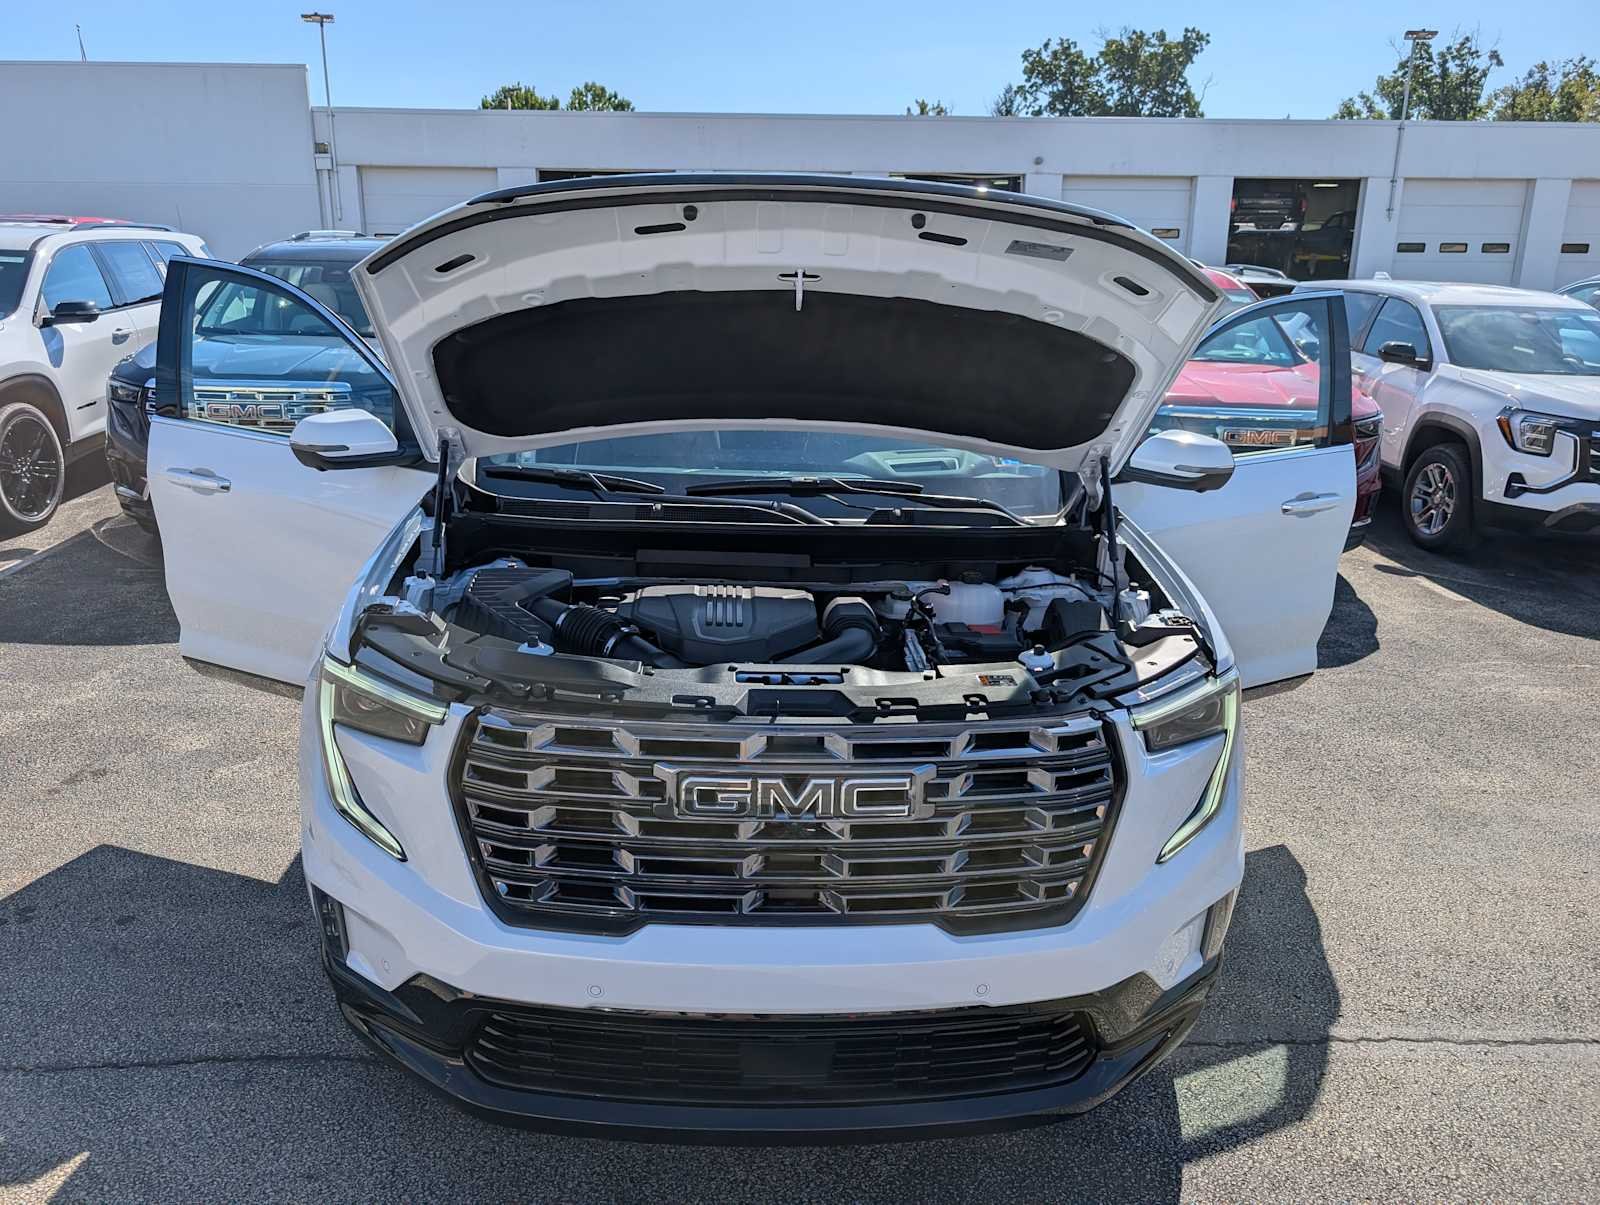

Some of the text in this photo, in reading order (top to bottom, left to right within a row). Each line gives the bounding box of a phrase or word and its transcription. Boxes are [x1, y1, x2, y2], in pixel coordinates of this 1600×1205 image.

[207, 403, 280, 419] GMC
[1224, 430, 1292, 444] GMC
[681, 777, 911, 816] GMC
